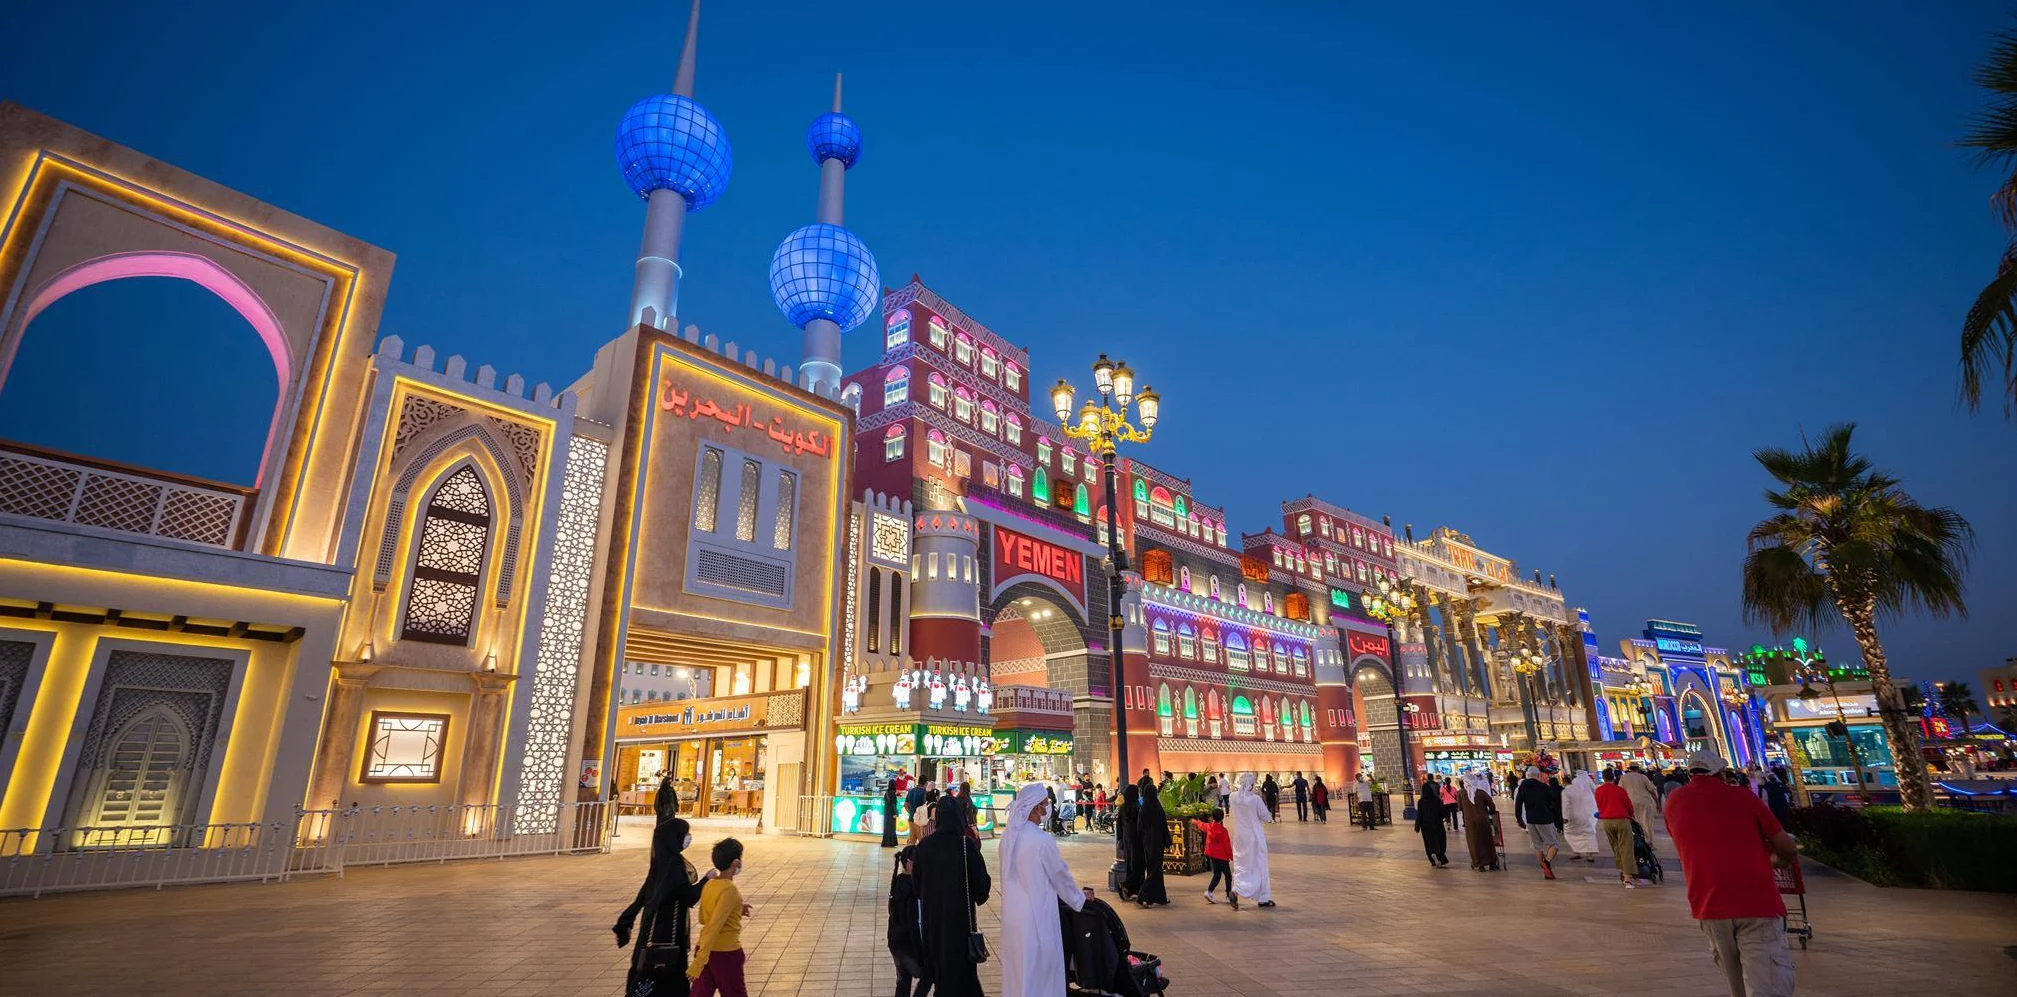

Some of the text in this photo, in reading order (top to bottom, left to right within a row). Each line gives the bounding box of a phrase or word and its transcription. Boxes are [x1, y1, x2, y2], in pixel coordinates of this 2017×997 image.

[998, 530, 1080, 584] YEMEN
[1349, 636, 1389, 656] اليمن
[1749, 672, 1767, 685] KSA
[840, 724, 911, 736] TURKISH ICE CREAM
[928, 725, 992, 738] TURKISH ICE CREAM
